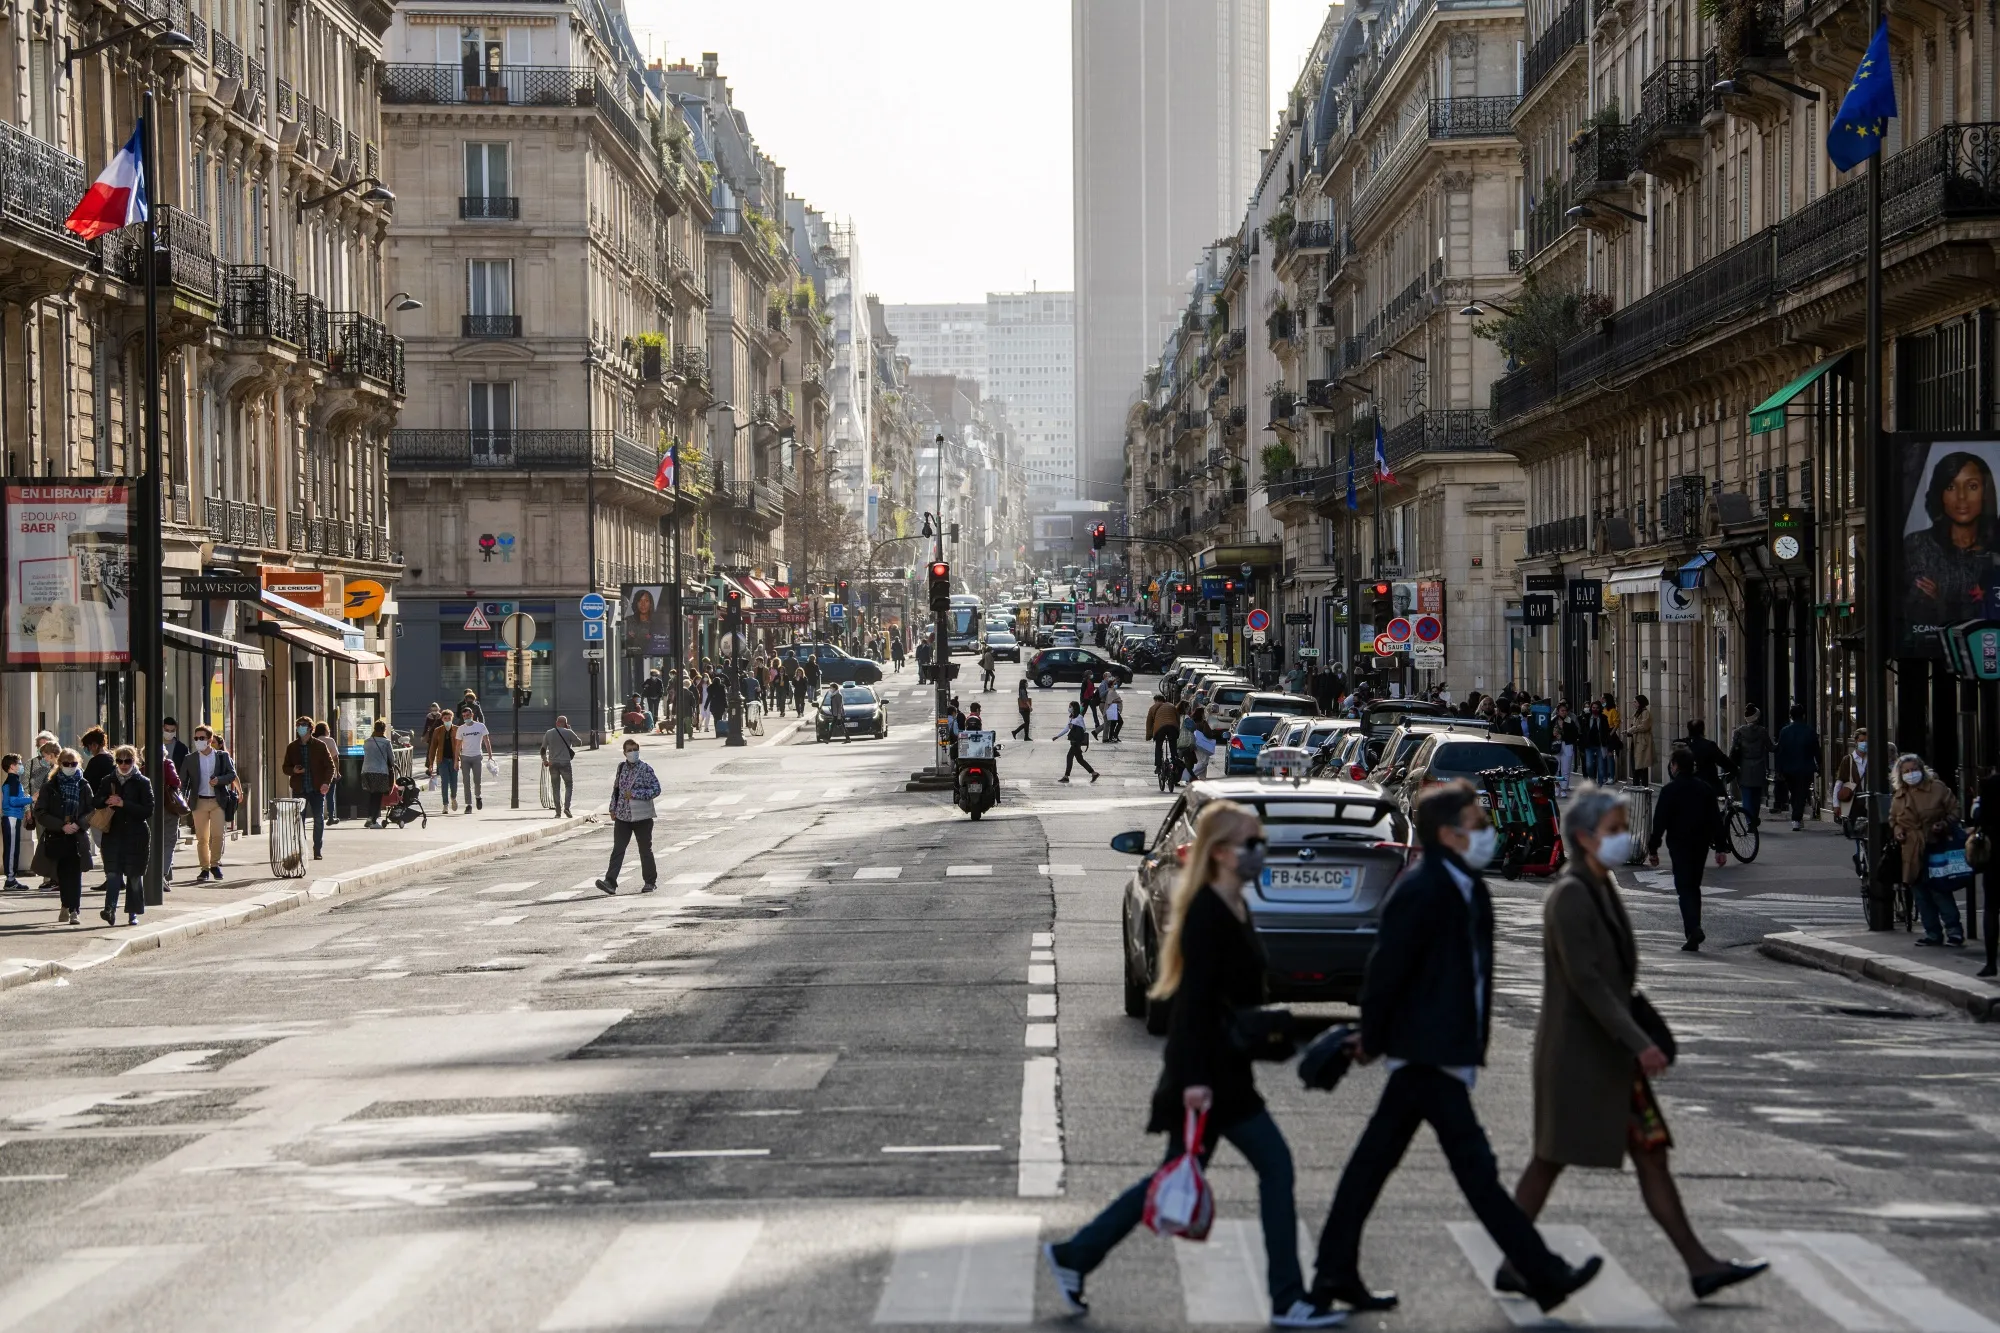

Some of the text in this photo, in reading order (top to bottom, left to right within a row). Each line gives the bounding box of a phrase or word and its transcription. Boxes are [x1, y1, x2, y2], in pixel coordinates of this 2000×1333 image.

[21, 488, 39, 499] EN
[43, 488, 105, 499] LIBRAIRIE
[21, 511, 77, 521] EDOUARD
[21, 523, 56, 533] BAER
[204, 582, 257, 593] WESTON
[1576, 587, 1595, 601] GAP
[833, 607, 840, 615] P
[1530, 603, 1547, 617] GAP
[588, 624, 598, 637] P
[1912, 624, 1937, 633] SCAN
[1984, 647, 1996, 656] 39
[1984, 661, 1996, 670] 95
[1538, 714, 1546, 726] P
[1270, 750, 1296, 759] TAXI
